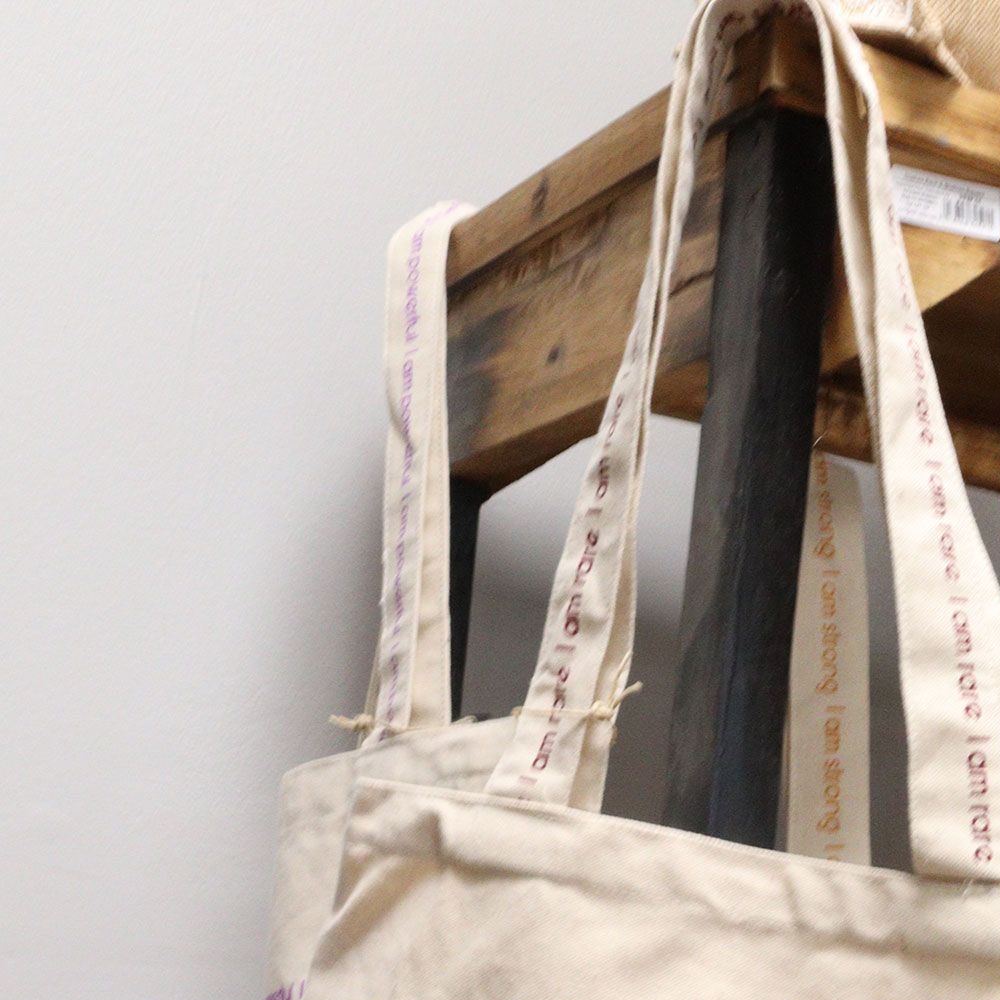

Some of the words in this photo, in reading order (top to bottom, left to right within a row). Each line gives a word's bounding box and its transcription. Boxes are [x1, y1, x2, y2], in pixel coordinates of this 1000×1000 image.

[532, 731, 557, 771] am
[563, 594, 583, 637] am
[574, 530, 599, 587] rare
[953, 610, 973, 656] am
[957, 662, 983, 720] rare
[816, 758, 845, 835] strong
[968, 751, 989, 799] am
[969, 804, 993, 863] rare
